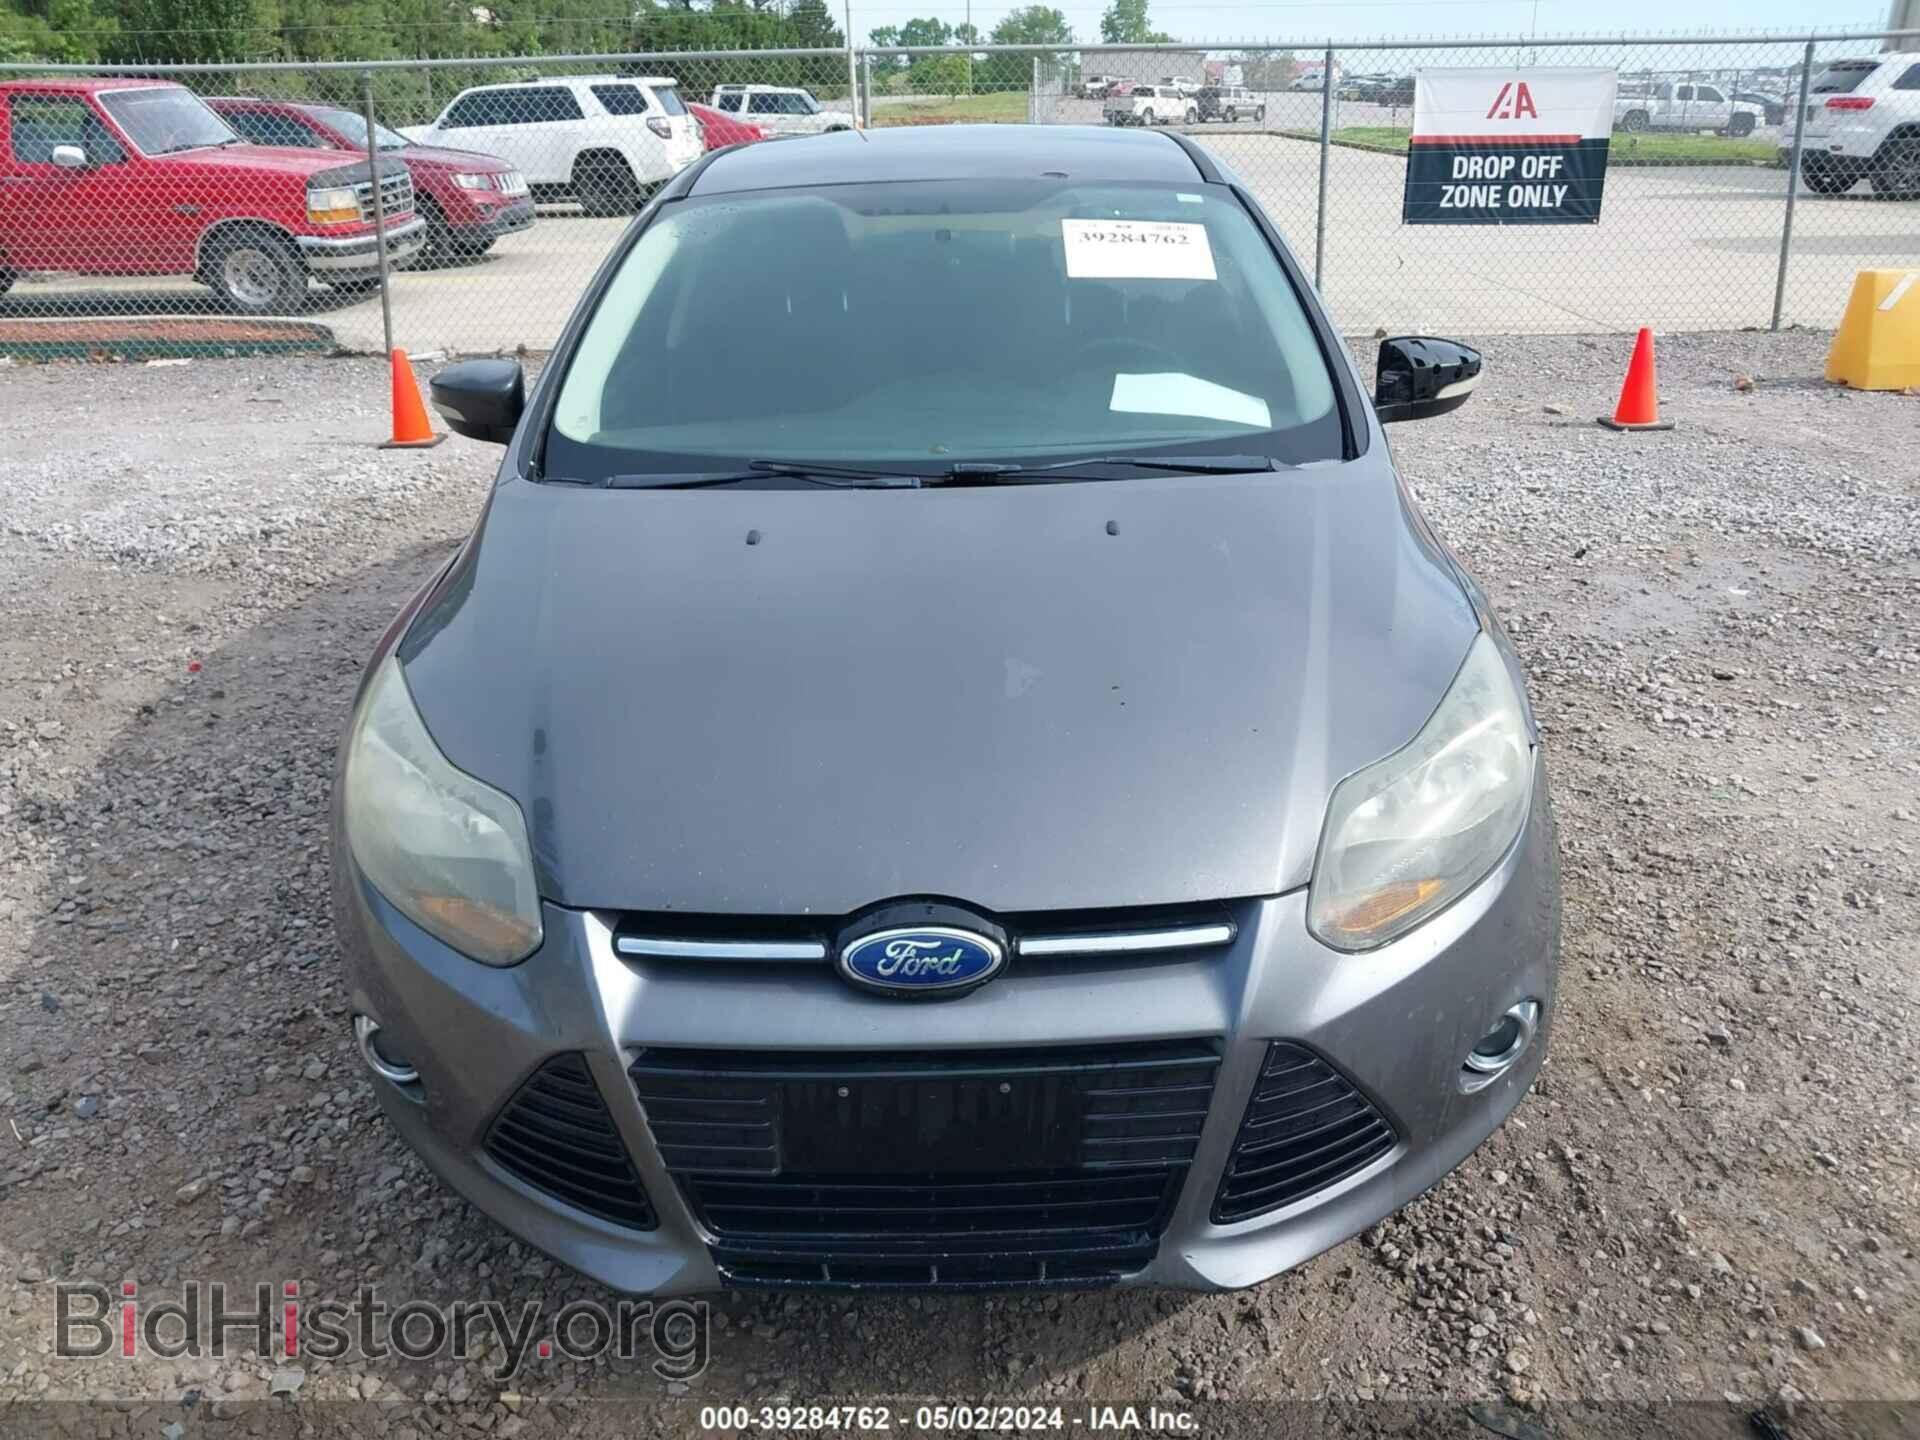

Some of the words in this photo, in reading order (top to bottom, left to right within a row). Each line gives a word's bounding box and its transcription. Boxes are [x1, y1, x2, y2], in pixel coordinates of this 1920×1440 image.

[1452, 155, 1515, 179] DROP
[1521, 155, 1564, 179] OFF
[1440, 185, 1502, 208] ZONE
[1508, 184, 1568, 208] ONLY
[1079, 231, 1191, 245] 39284762
[876, 940, 964, 976] Ford
